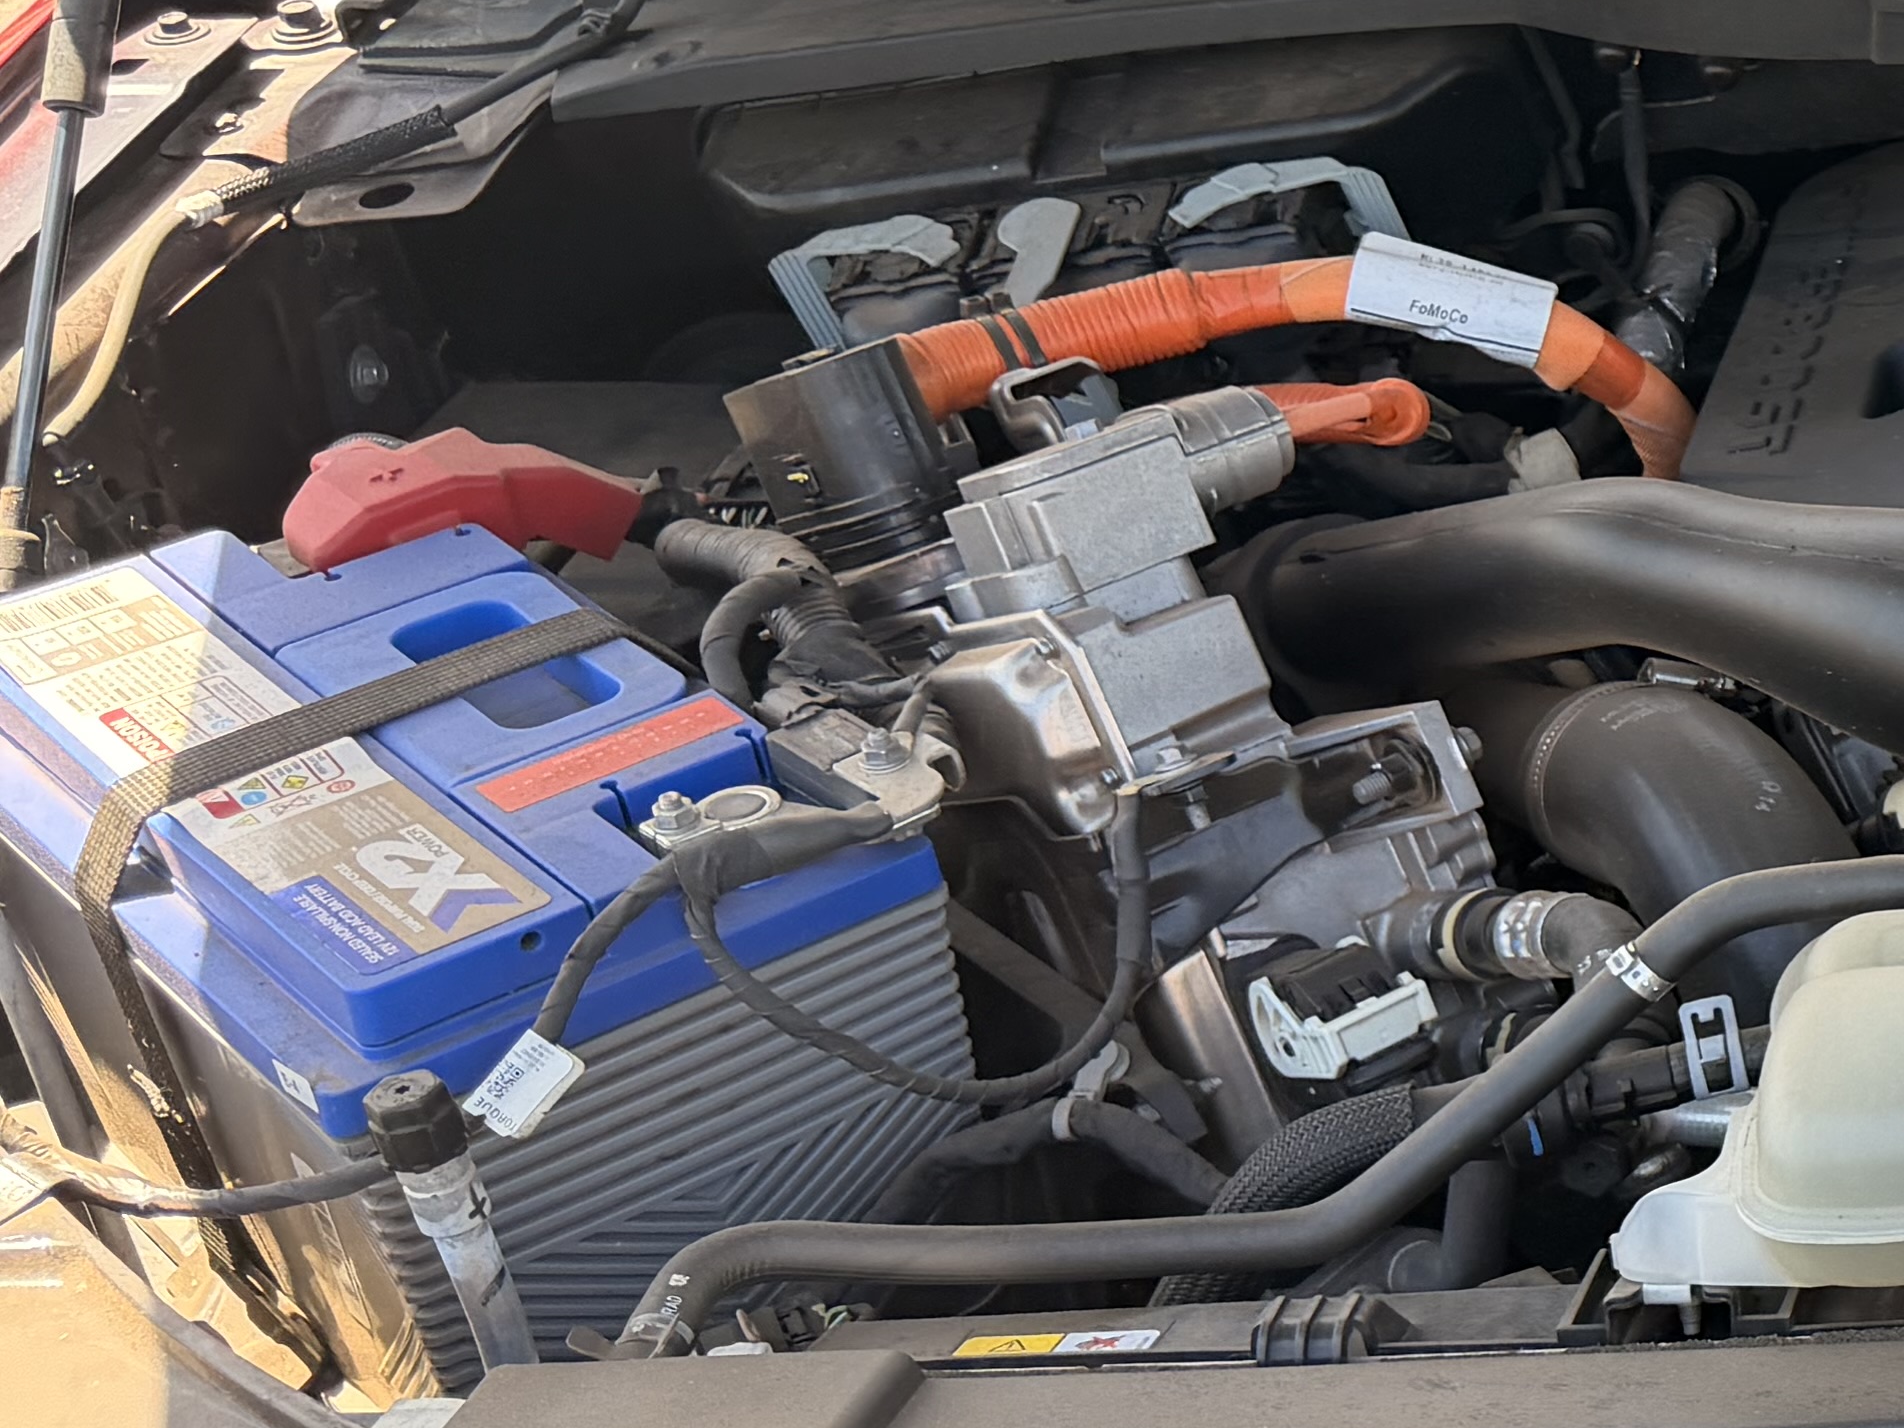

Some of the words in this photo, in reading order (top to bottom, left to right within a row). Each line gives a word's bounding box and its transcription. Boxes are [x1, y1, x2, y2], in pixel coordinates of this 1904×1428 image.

[1408, 298, 1470, 324] FoMoCo
[109, 716, 169, 762] POISON
[406, 827, 449, 857] POWER
[356, 823, 502, 917] X2
[303, 883, 346, 912] BATTERY
[338, 910, 365, 926] ACID
[357, 925, 386, 944] LEAD
[347, 938, 384, 963] SEALED
[378, 942, 400, 956] 12V
[473, 1096, 518, 1132] TORQUE
